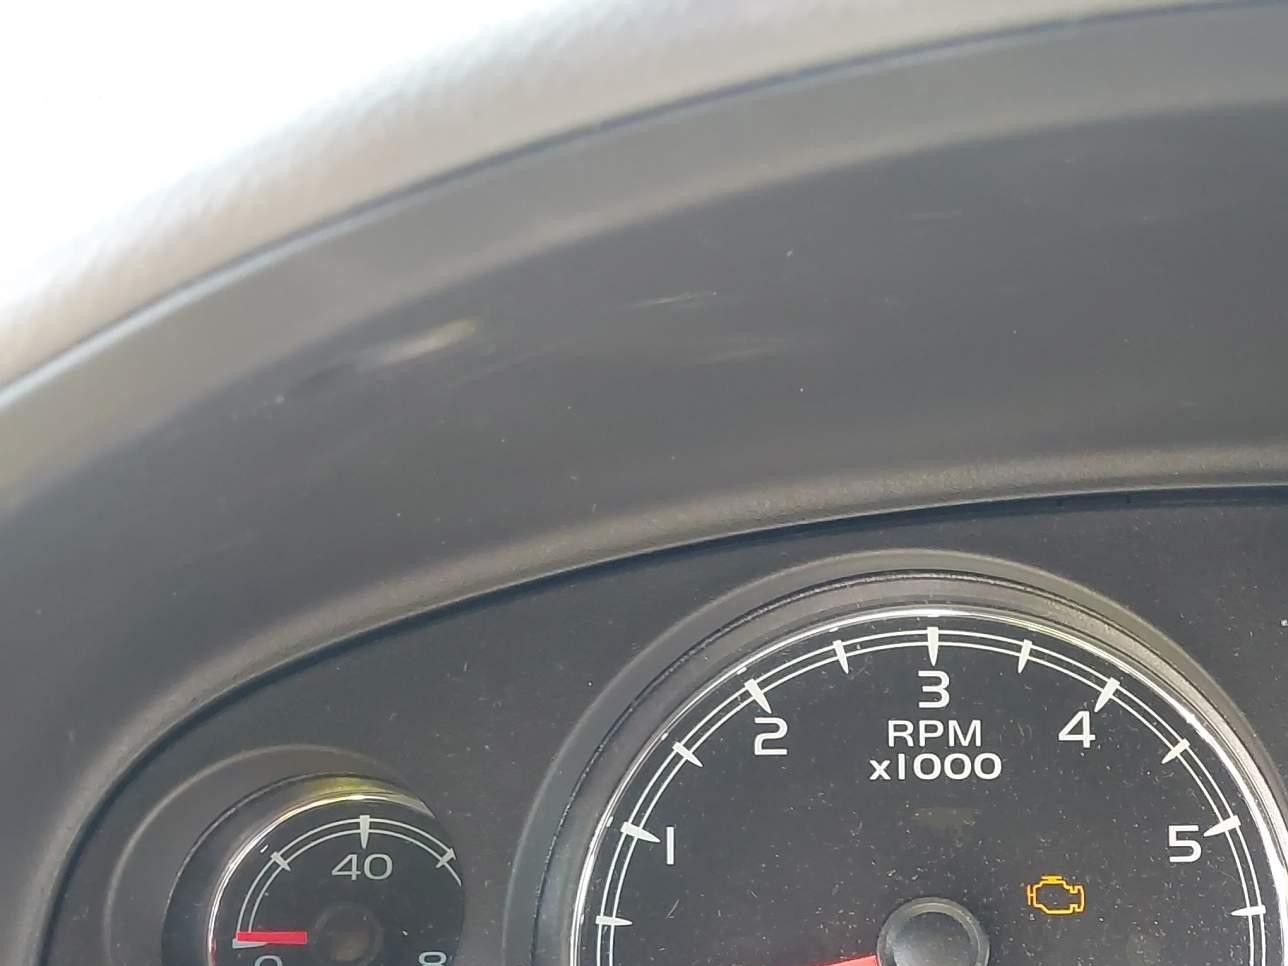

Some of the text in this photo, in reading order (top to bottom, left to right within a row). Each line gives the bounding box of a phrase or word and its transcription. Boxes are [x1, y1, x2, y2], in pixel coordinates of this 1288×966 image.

[918, 671, 950, 709] 3
[753, 717, 789, 756] 2
[888, 720, 982, 747] RPM
[1058, 710, 1096, 748] 4
[869, 753, 1003, 780] x1000
[666, 826, 675, 865] 1
[1168, 825, 1202, 863] 5
[331, 854, 393, 880] 40
